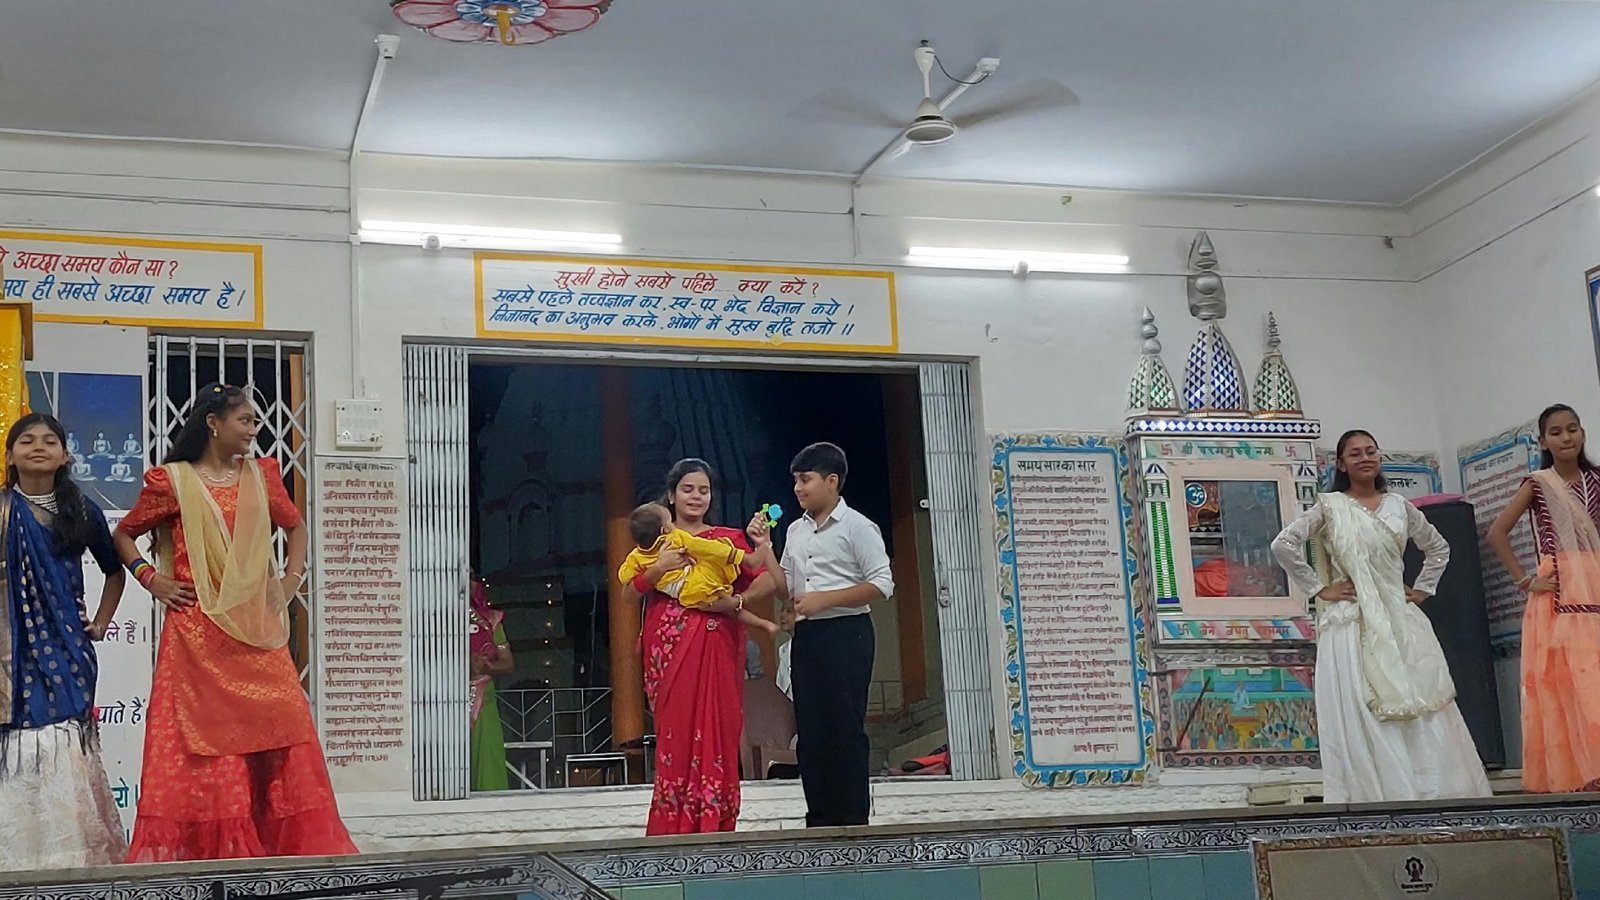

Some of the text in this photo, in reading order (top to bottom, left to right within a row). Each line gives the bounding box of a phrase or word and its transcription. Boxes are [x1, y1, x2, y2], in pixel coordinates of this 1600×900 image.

[13, 251, 60, 273] अच्छा
[61, 255, 106, 274] समय
[109, 250, 143, 275] कौन
[4, 279, 29, 298] मय
[32, 274, 55, 301] ही
[57, 276, 101, 302] सबसे
[104, 283, 155, 305] अच्छा
[162, 287, 210, 306] समय
[216, 281, 236, 309] है
[554, 266, 596, 289] सुखी
[597, 267, 632, 290] होने
[633, 271, 676, 290] सबसे
[681, 272, 718, 294] पहिले
[737, 279, 772, 294] क्या
[779, 277, 808, 296] करें
[492, 284, 535, 304] सबसे
[537, 288, 575, 307] पहले
[723, 294, 751, 315] भेद
[756, 295, 806, 316] विज्ञान
[545, 311, 562, 324] का
[565, 311, 618, 331] अनुभव
[707, 313, 723, 331] में
[725, 318, 763, 336] सुख
[801, 317, 838, 336] तजो
[106, 620, 121, 642] ले
[111, 776, 130, 809] रो
